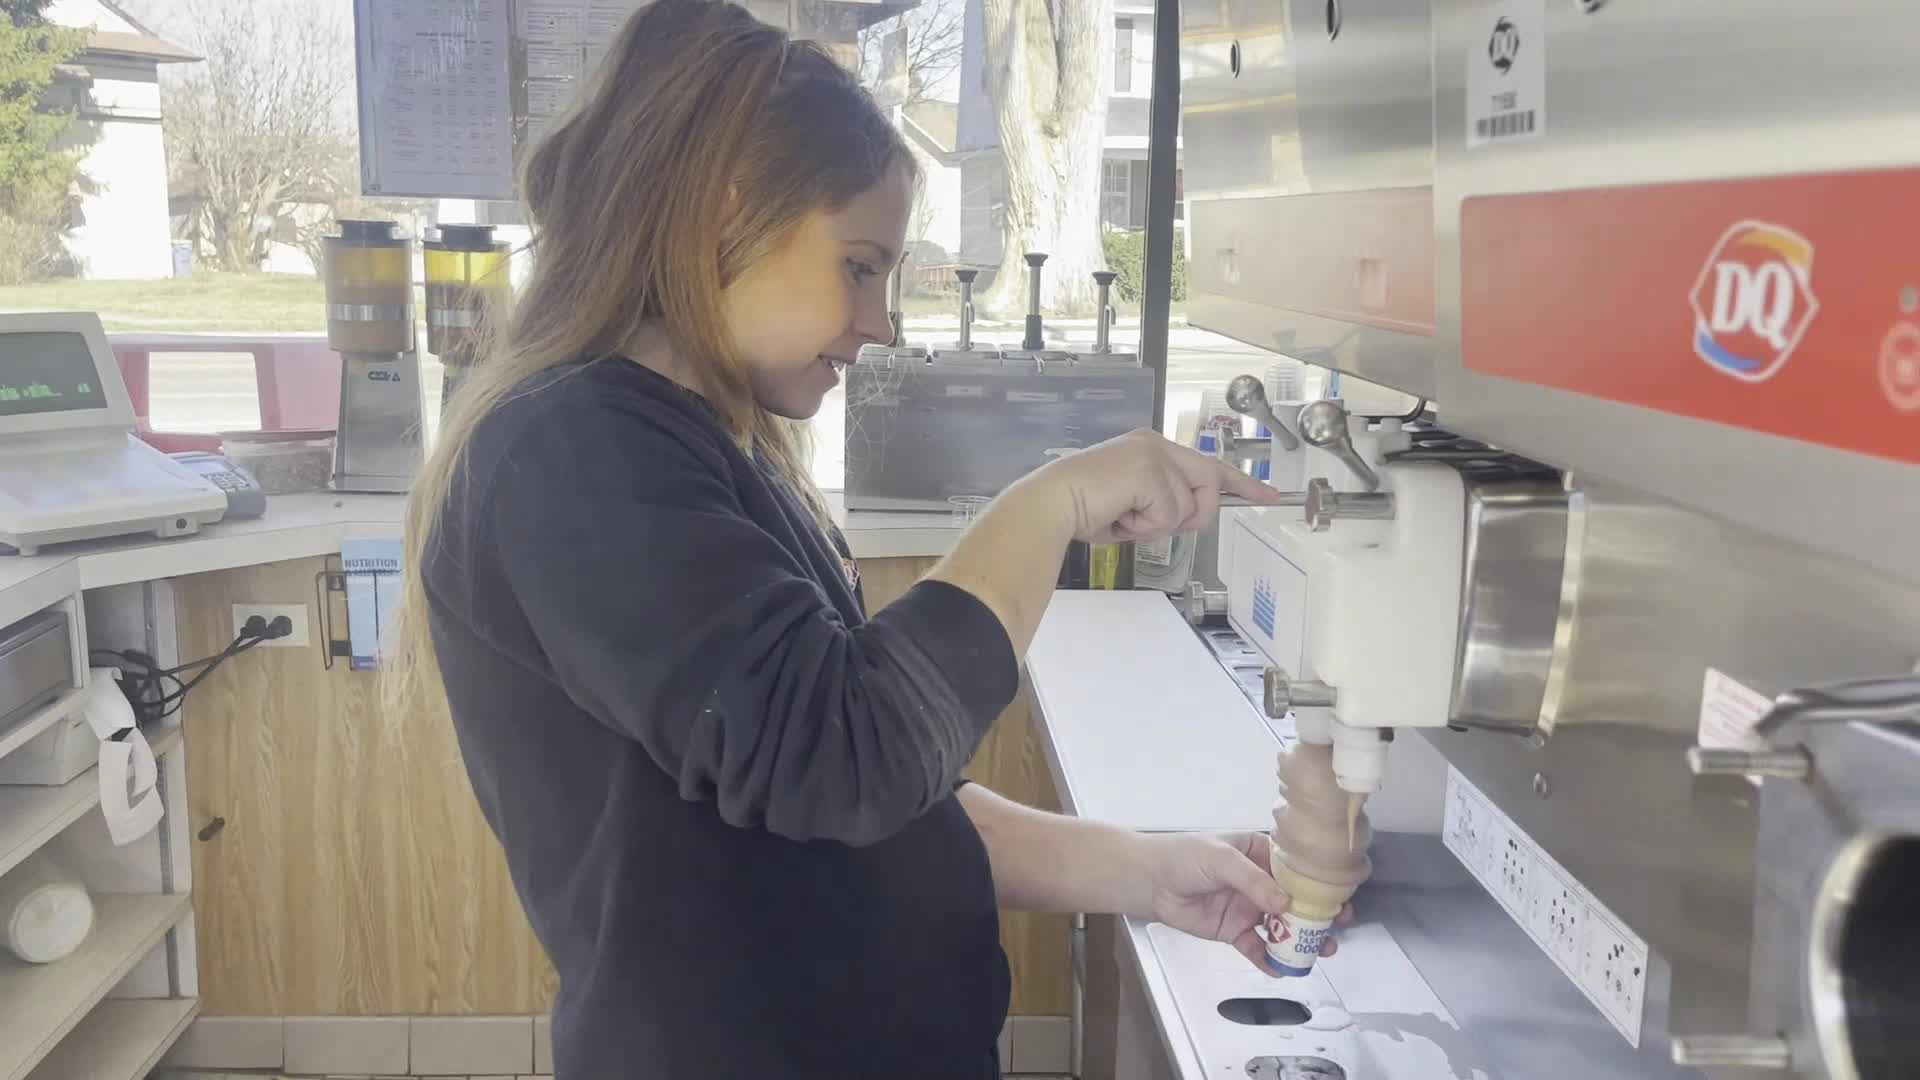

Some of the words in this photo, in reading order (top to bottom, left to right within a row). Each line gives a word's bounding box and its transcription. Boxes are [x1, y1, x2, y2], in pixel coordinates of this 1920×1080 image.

[1711, 261, 1794, 350] DQ
[344, 559, 399, 568] NUTRITION
[1294, 944, 1320, 954] GOO
